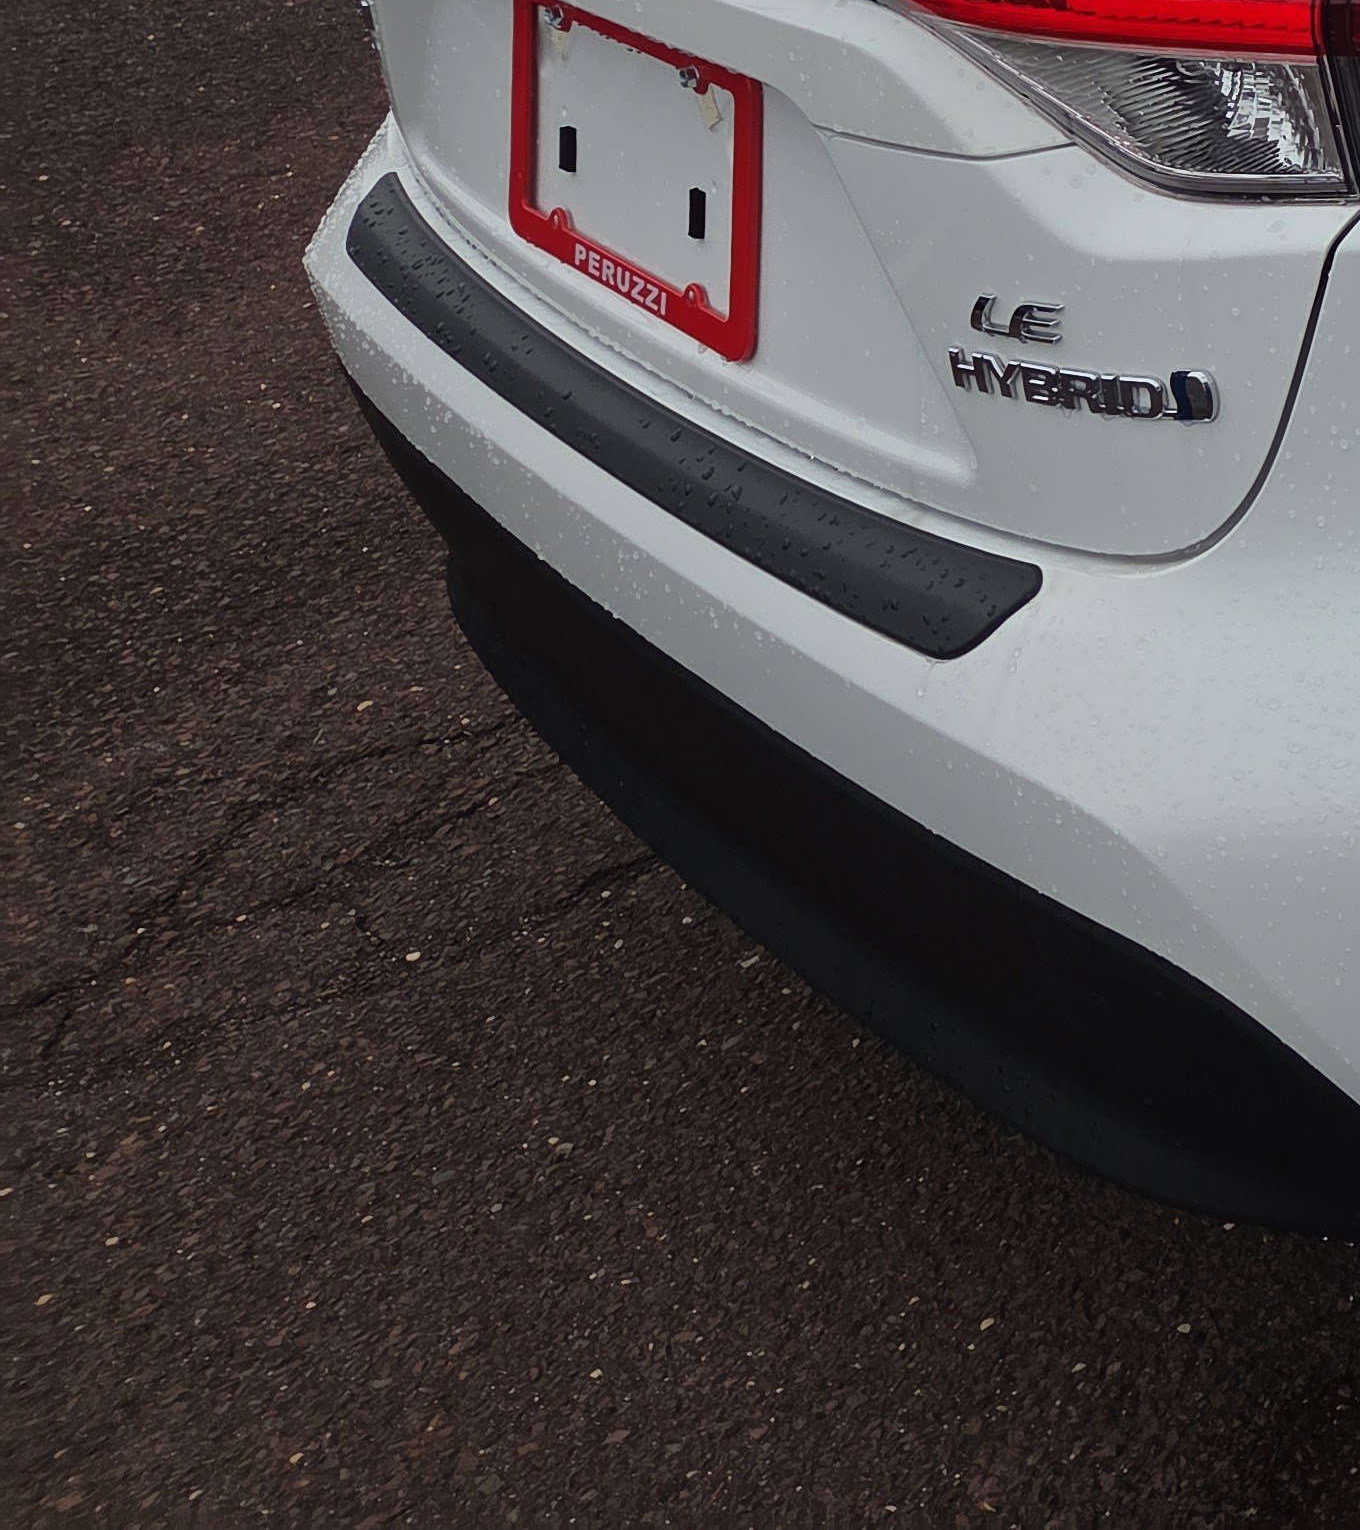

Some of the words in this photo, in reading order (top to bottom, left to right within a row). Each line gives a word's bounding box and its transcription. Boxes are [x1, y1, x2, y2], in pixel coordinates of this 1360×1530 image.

[574, 243, 667, 316] PERUZZI
[970, 293, 1065, 344] LE
[948, 346, 1168, 420] HYBRID
